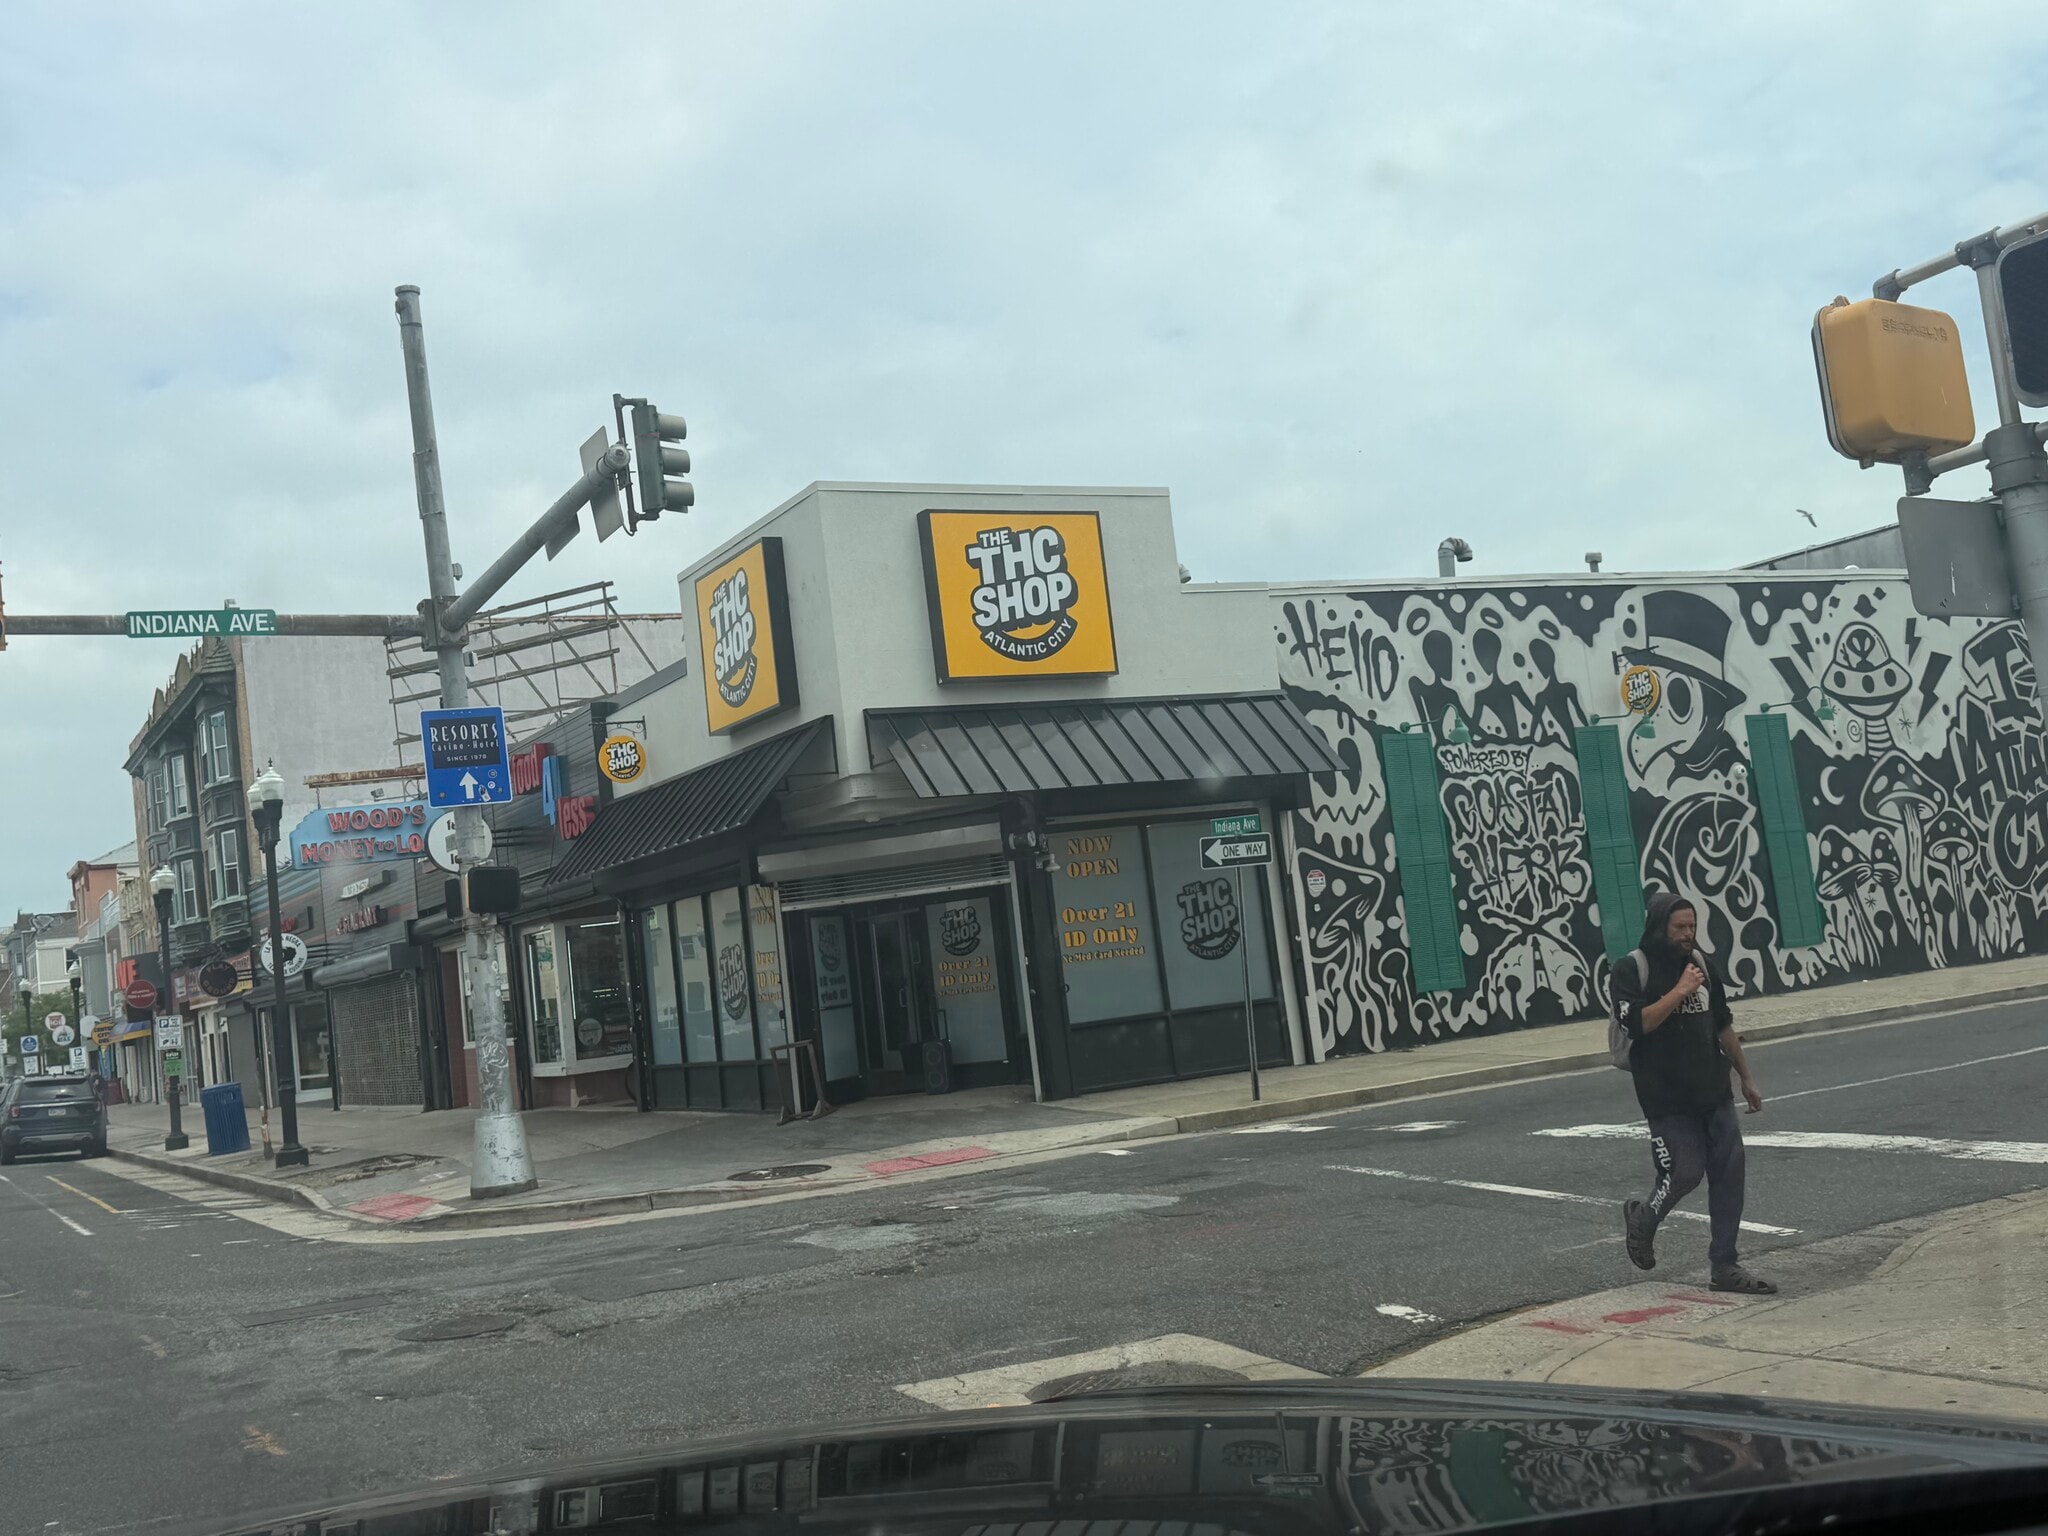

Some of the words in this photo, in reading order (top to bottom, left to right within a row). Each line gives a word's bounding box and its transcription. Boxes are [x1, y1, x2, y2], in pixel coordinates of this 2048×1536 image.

[979, 530, 1010, 548] THE
[968, 528, 1061, 585] THC
[714, 582, 727, 604] THE
[973, 572, 1072, 627] SHOP
[710, 570, 748, 641] THC
[129, 613, 219, 635] INDIANA
[229, 612, 275, 632] AVE.
[714, 611, 754, 681] SHOP
[985, 631, 1047, 656] ATLANTIC
[1047, 618, 1072, 647] CITY
[720, 683, 746, 703] ATLANTIC
[745, 658, 756, 689] CITY
[1627, 671, 1649, 690] THC
[1628, 684, 1652, 702] SHOP
[430, 723, 498, 742] RESORTS
[431, 742, 464, 752] Casino
[472, 739, 499, 749] Hotel
[607, 742, 636, 759] THC
[608, 754, 639, 771] SHOP
[1440, 744, 1510, 773] POWERED
[1513, 746, 1534, 776] BY
[327, 804, 427, 833] WOOD'S
[557, 796, 590, 840] less
[1214, 820, 1240, 833] Indiana
[1243, 818, 1256, 830] Ave
[300, 837, 376, 865] MONEY
[395, 832, 424, 855] LO
[1067, 835, 1112, 855] NOW
[1222, 845, 1240, 857] ONE
[1245, 843, 1263, 855] WAY
[1066, 858, 1119, 878] OPEN
[1458, 835, 1588, 908] HERB
[1179, 879, 1229, 917] THC
[1184, 883, 1201, 895] THE
[941, 907, 975, 931] THC
[1062, 907, 1108, 925] Over
[1114, 901, 1136, 918] 21
[1182, 905, 1236, 942] SHOP
[943, 923, 980, 947] SHOP
[1064, 930, 1086, 948] ID
[1093, 925, 1138, 945] Only
[1189, 944, 1225, 958] ATLANTIC
[1224, 932, 1238, 951] CITY
[720, 944, 742, 977] THC
[938, 959, 971, 972] Over
[975, 956, 990, 969] 21
[1075, 952, 1092, 962] Med
[1094, 949, 1113, 960] Card
[1114, 946, 1146, 957] Needed
[723, 971, 746, 1002] SHOP
[940, 975, 956, 988] ID
[959, 972, 991, 985] Only
